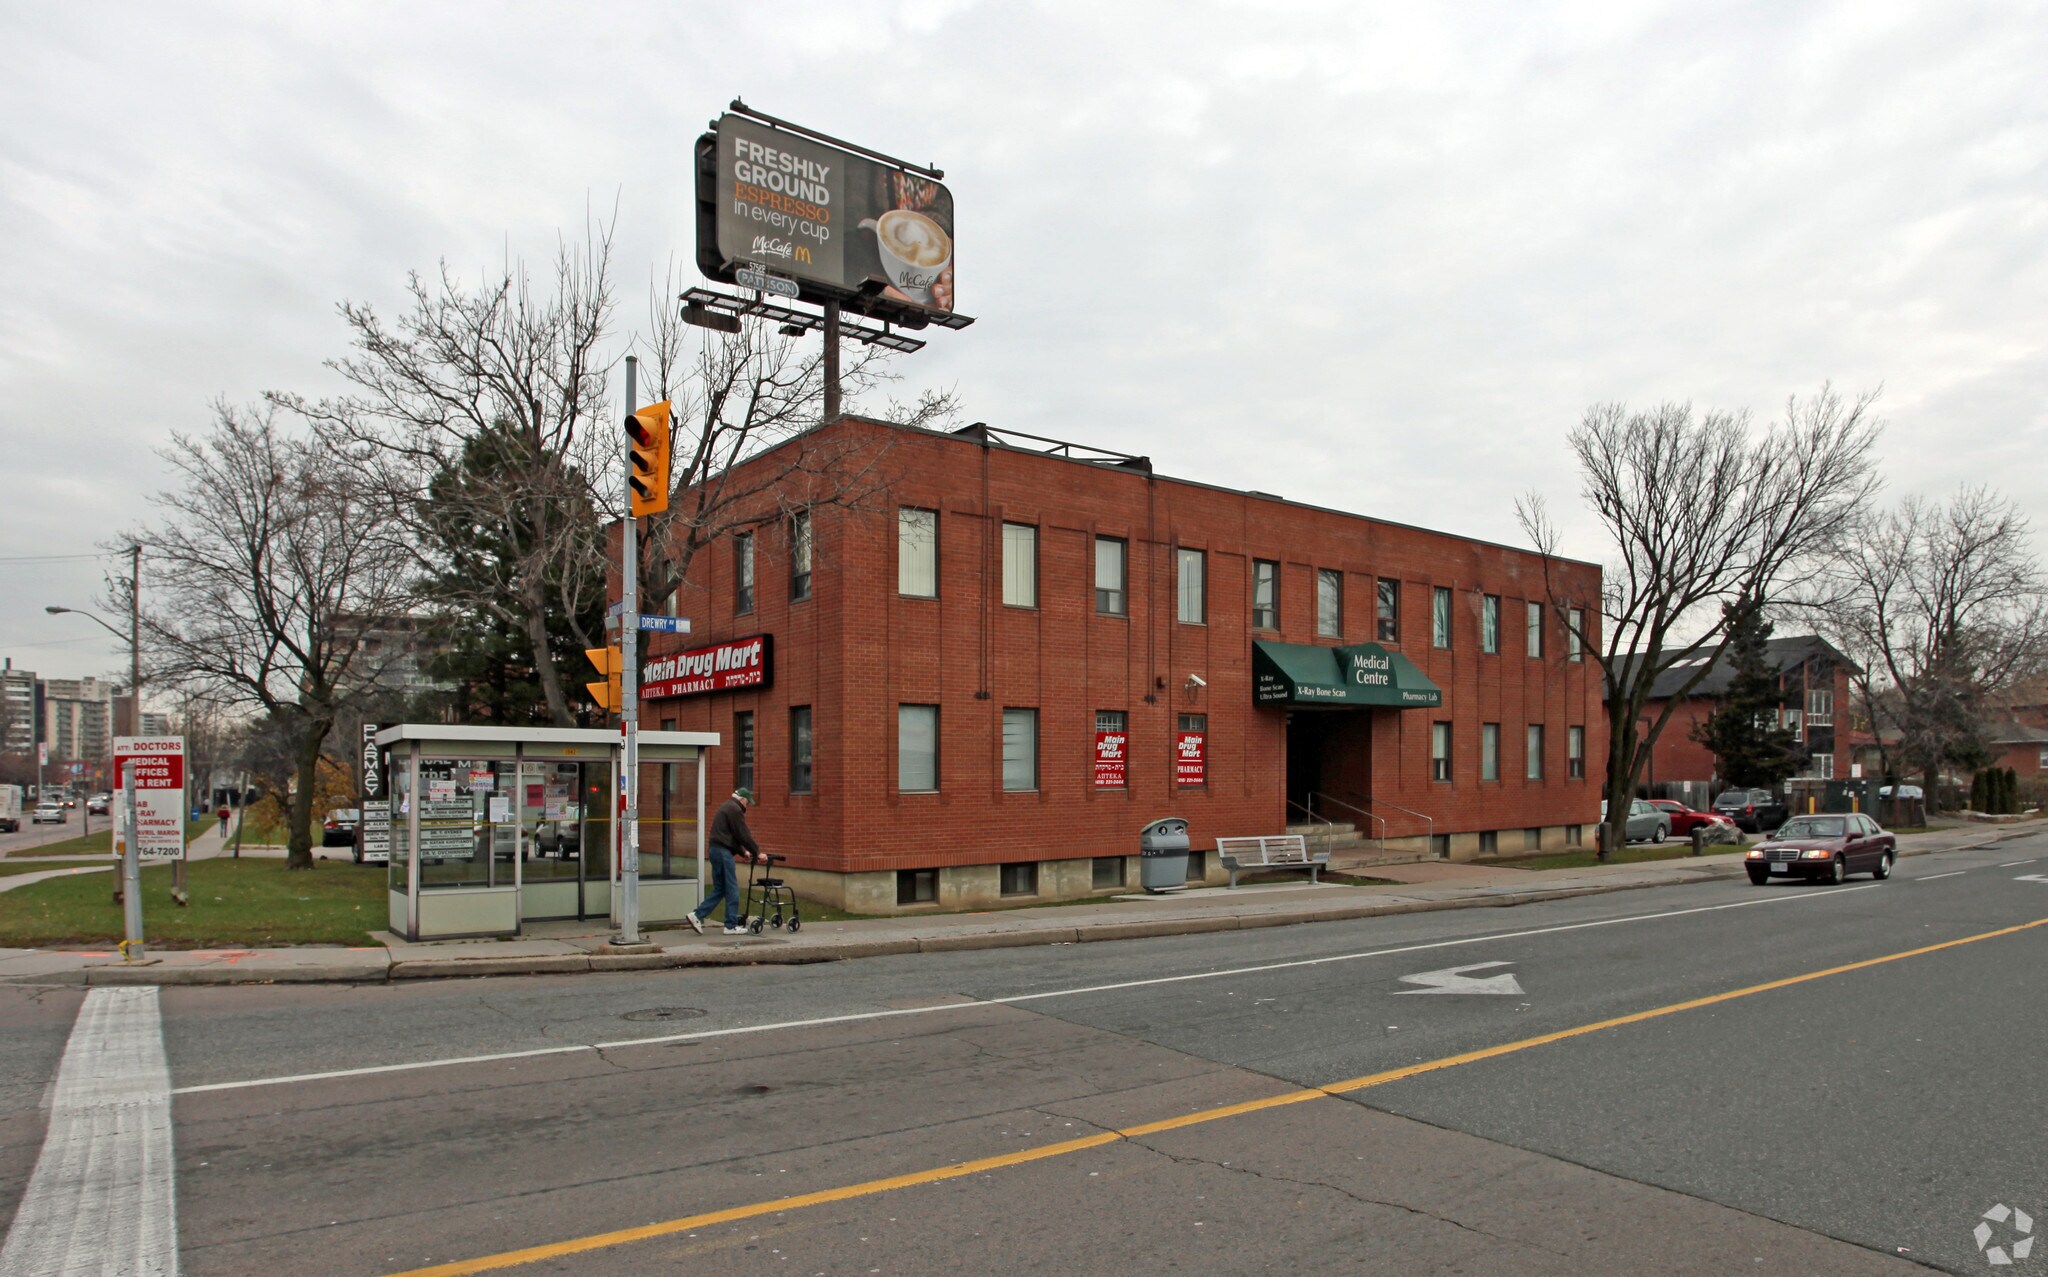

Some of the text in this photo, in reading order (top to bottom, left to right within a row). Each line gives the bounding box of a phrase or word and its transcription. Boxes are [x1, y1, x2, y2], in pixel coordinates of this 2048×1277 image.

[735, 137, 830, 184] FRESHLY
[734, 160, 830, 206] GROUND
[735, 182, 830, 224] ESPRESSO
[734, 198, 830, 245] in every cup
[641, 616, 668, 630] DREWRY
[643, 641, 762, 683] Main Drug Mart
[1354, 655, 1389, 670] Medical
[1356, 670, 1388, 685] Centre
[642, 687, 665, 698] АПТЕКА
[672, 679, 715, 695] PHARMACY
[1297, 687, 1346, 698] X-Ray Bone Scan
[1273, 691, 1288, 699] Sound
[1403, 692, 1438, 701] Pharmacy Lab
[1104, 735, 1125, 744] Main
[1184, 736, 1202, 744] Main
[133, 742, 181, 751] DOCTORS
[1097, 742, 1118, 751] Drug
[1178, 742, 1196, 751] Drug
[1101, 750, 1122, 758] Mart
[363, 724, 378, 796] PHARMACY
[135, 768, 169, 776] FFICES
[147, 779, 172, 787] RENT
